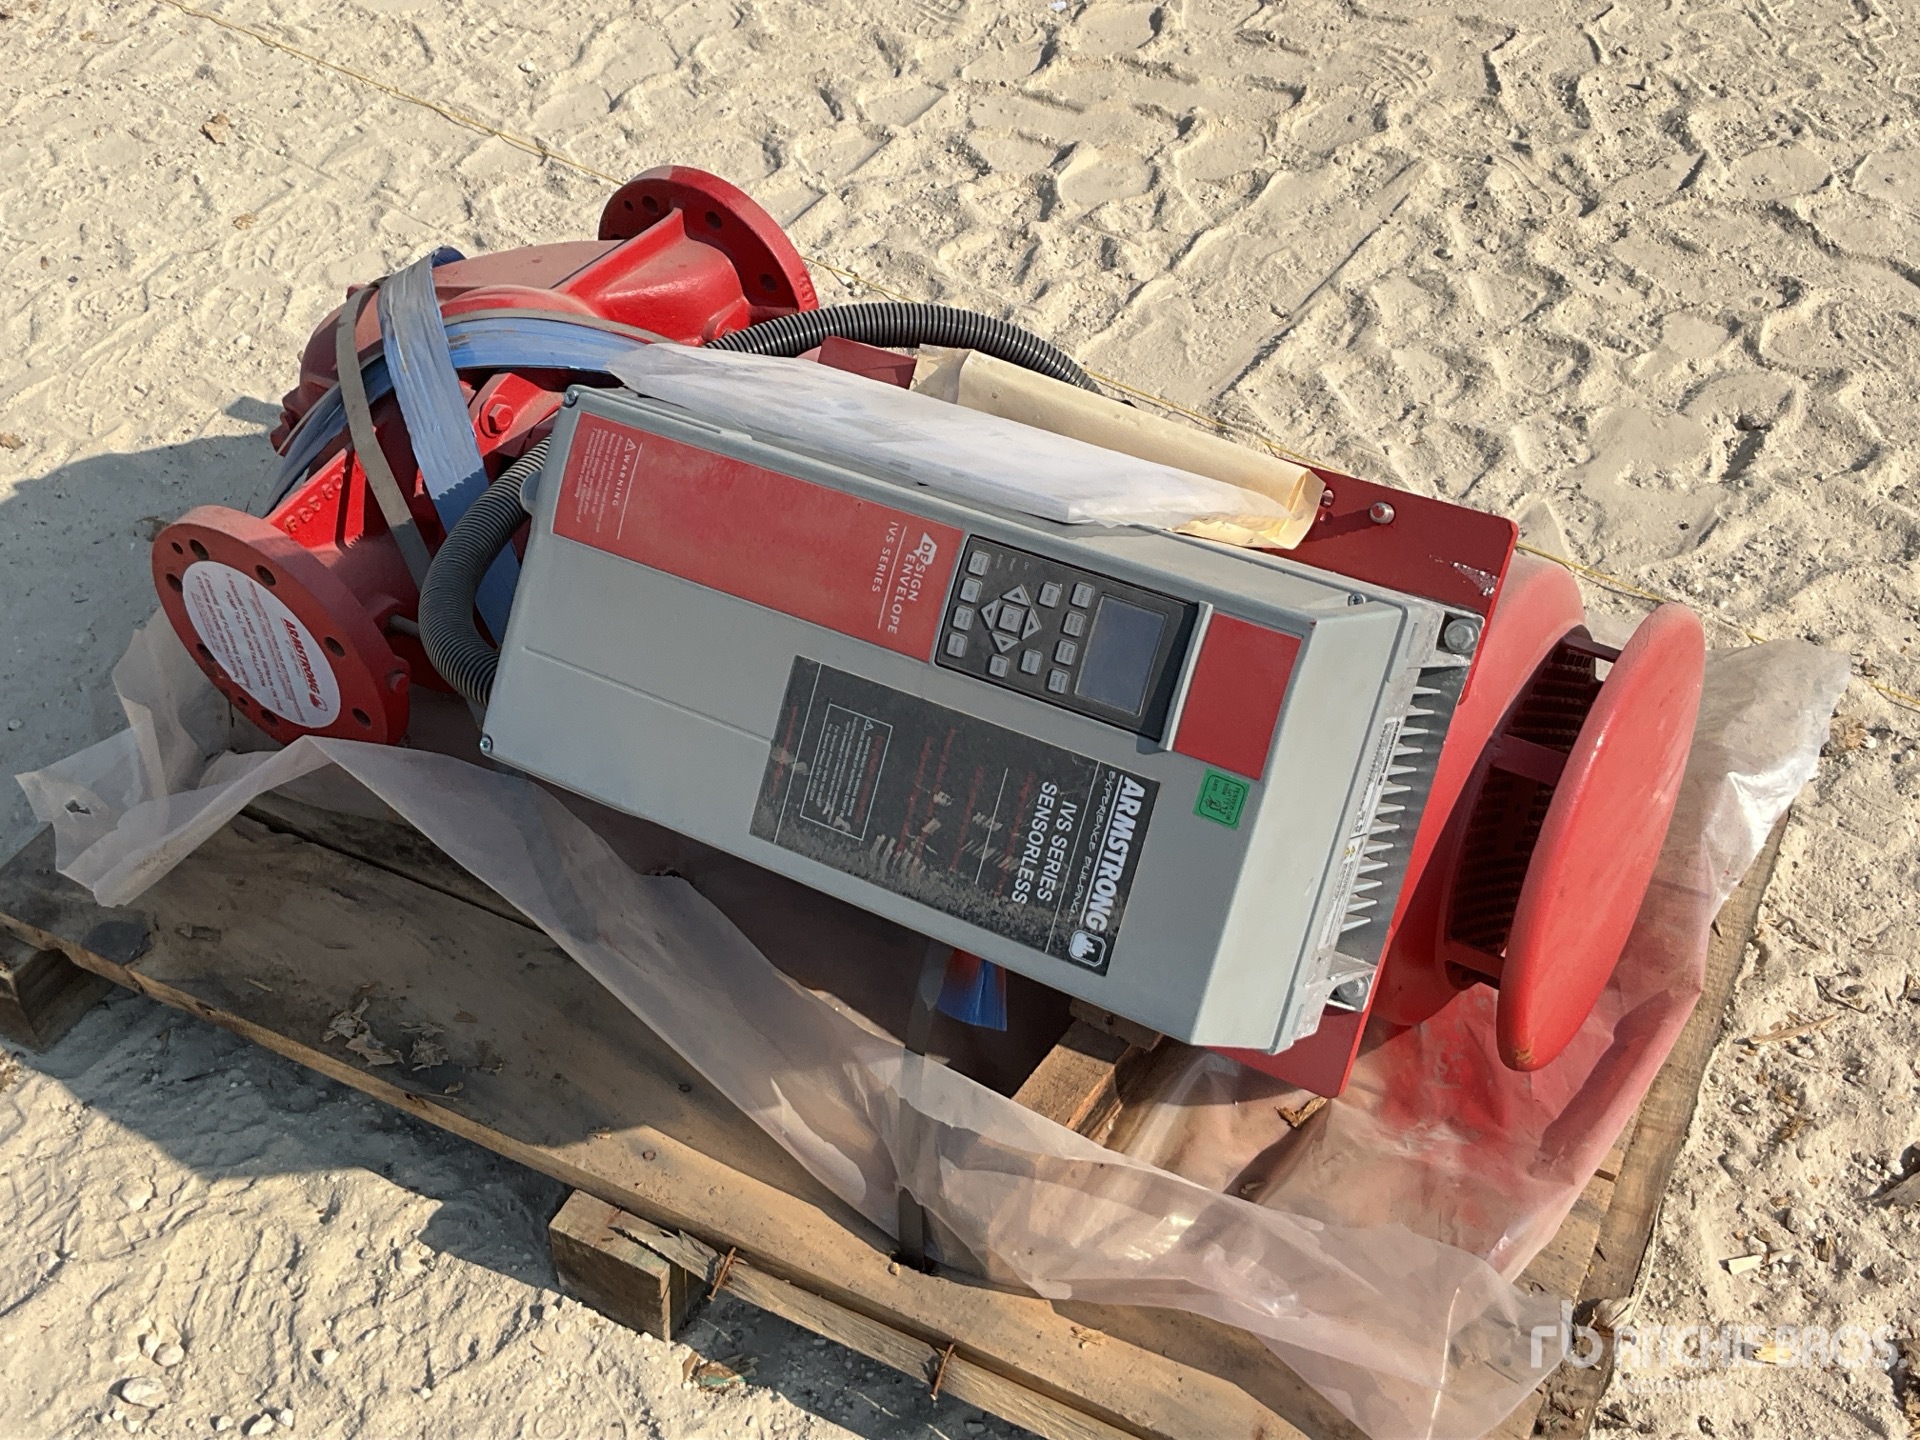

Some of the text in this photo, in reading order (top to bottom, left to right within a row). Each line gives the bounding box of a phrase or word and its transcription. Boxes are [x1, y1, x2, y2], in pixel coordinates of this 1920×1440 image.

[612, 453, 629, 506] WARNING
[872, 521, 898, 593] IVS SERIES
[887, 553, 915, 634] ENVELOPE
[908, 541, 930, 602] DESIGN
[195, 576, 210, 601] SYSTEM
[207, 605, 221, 629] BEFORE
[218, 634, 240, 677] INSTALLATION
[222, 623, 238, 653] FLUSHING
[224, 591, 237, 609] PUMP
[244, 641, 268, 685] INSTALLATION
[240, 609, 255, 633] FLANGE
[252, 638, 265, 658] COVER
[260, 662, 275, 685] REMAIN
[283, 618, 320, 691] ARMSTRONG
[1005, 612, 1014, 624] OK
[1010, 780, 1058, 904] SENSORLESS
[1086, 769, 1116, 853] EXPERIENCE
[1036, 800, 1076, 902] IVS SERIES
[1084, 776, 1146, 932] ARMSTRONG
